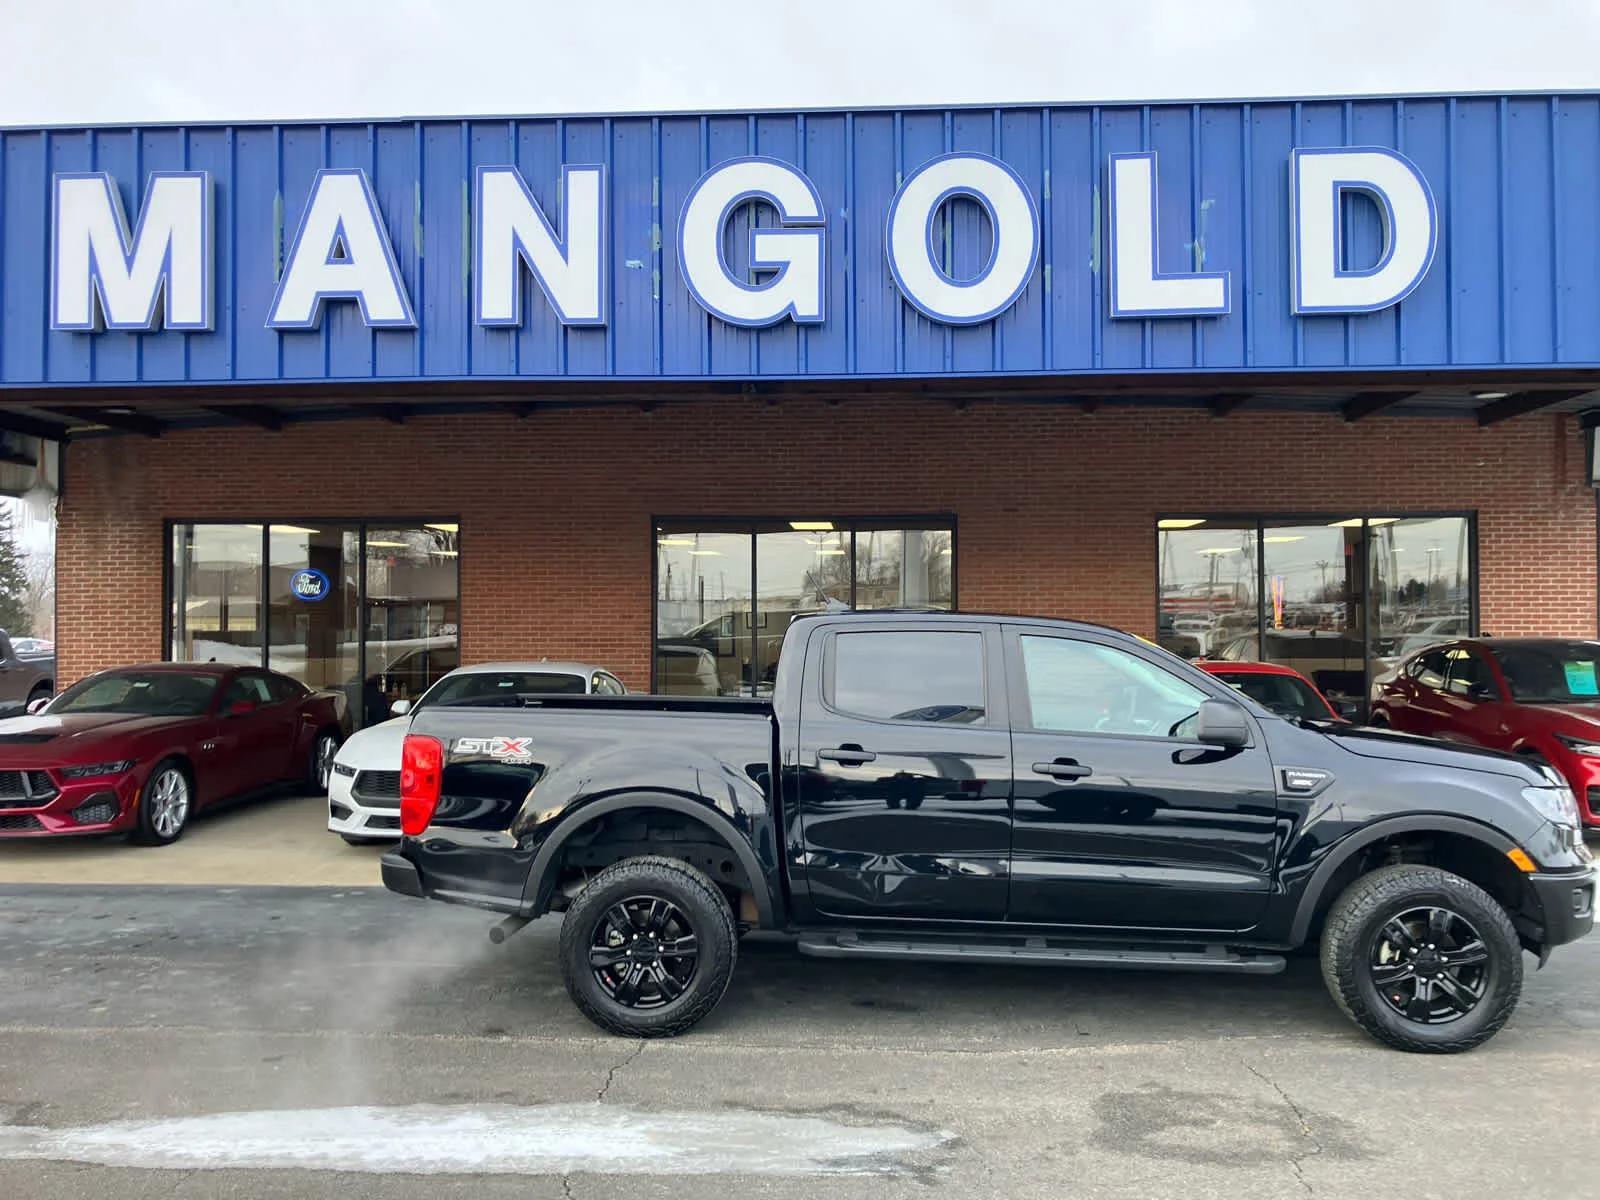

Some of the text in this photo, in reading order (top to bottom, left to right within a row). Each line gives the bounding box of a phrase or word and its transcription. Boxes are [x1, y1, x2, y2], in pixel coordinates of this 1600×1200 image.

[50, 145, 1438, 331] MANGOLD
[295, 572, 321, 595] Ford
[453, 736, 533, 757] STX
